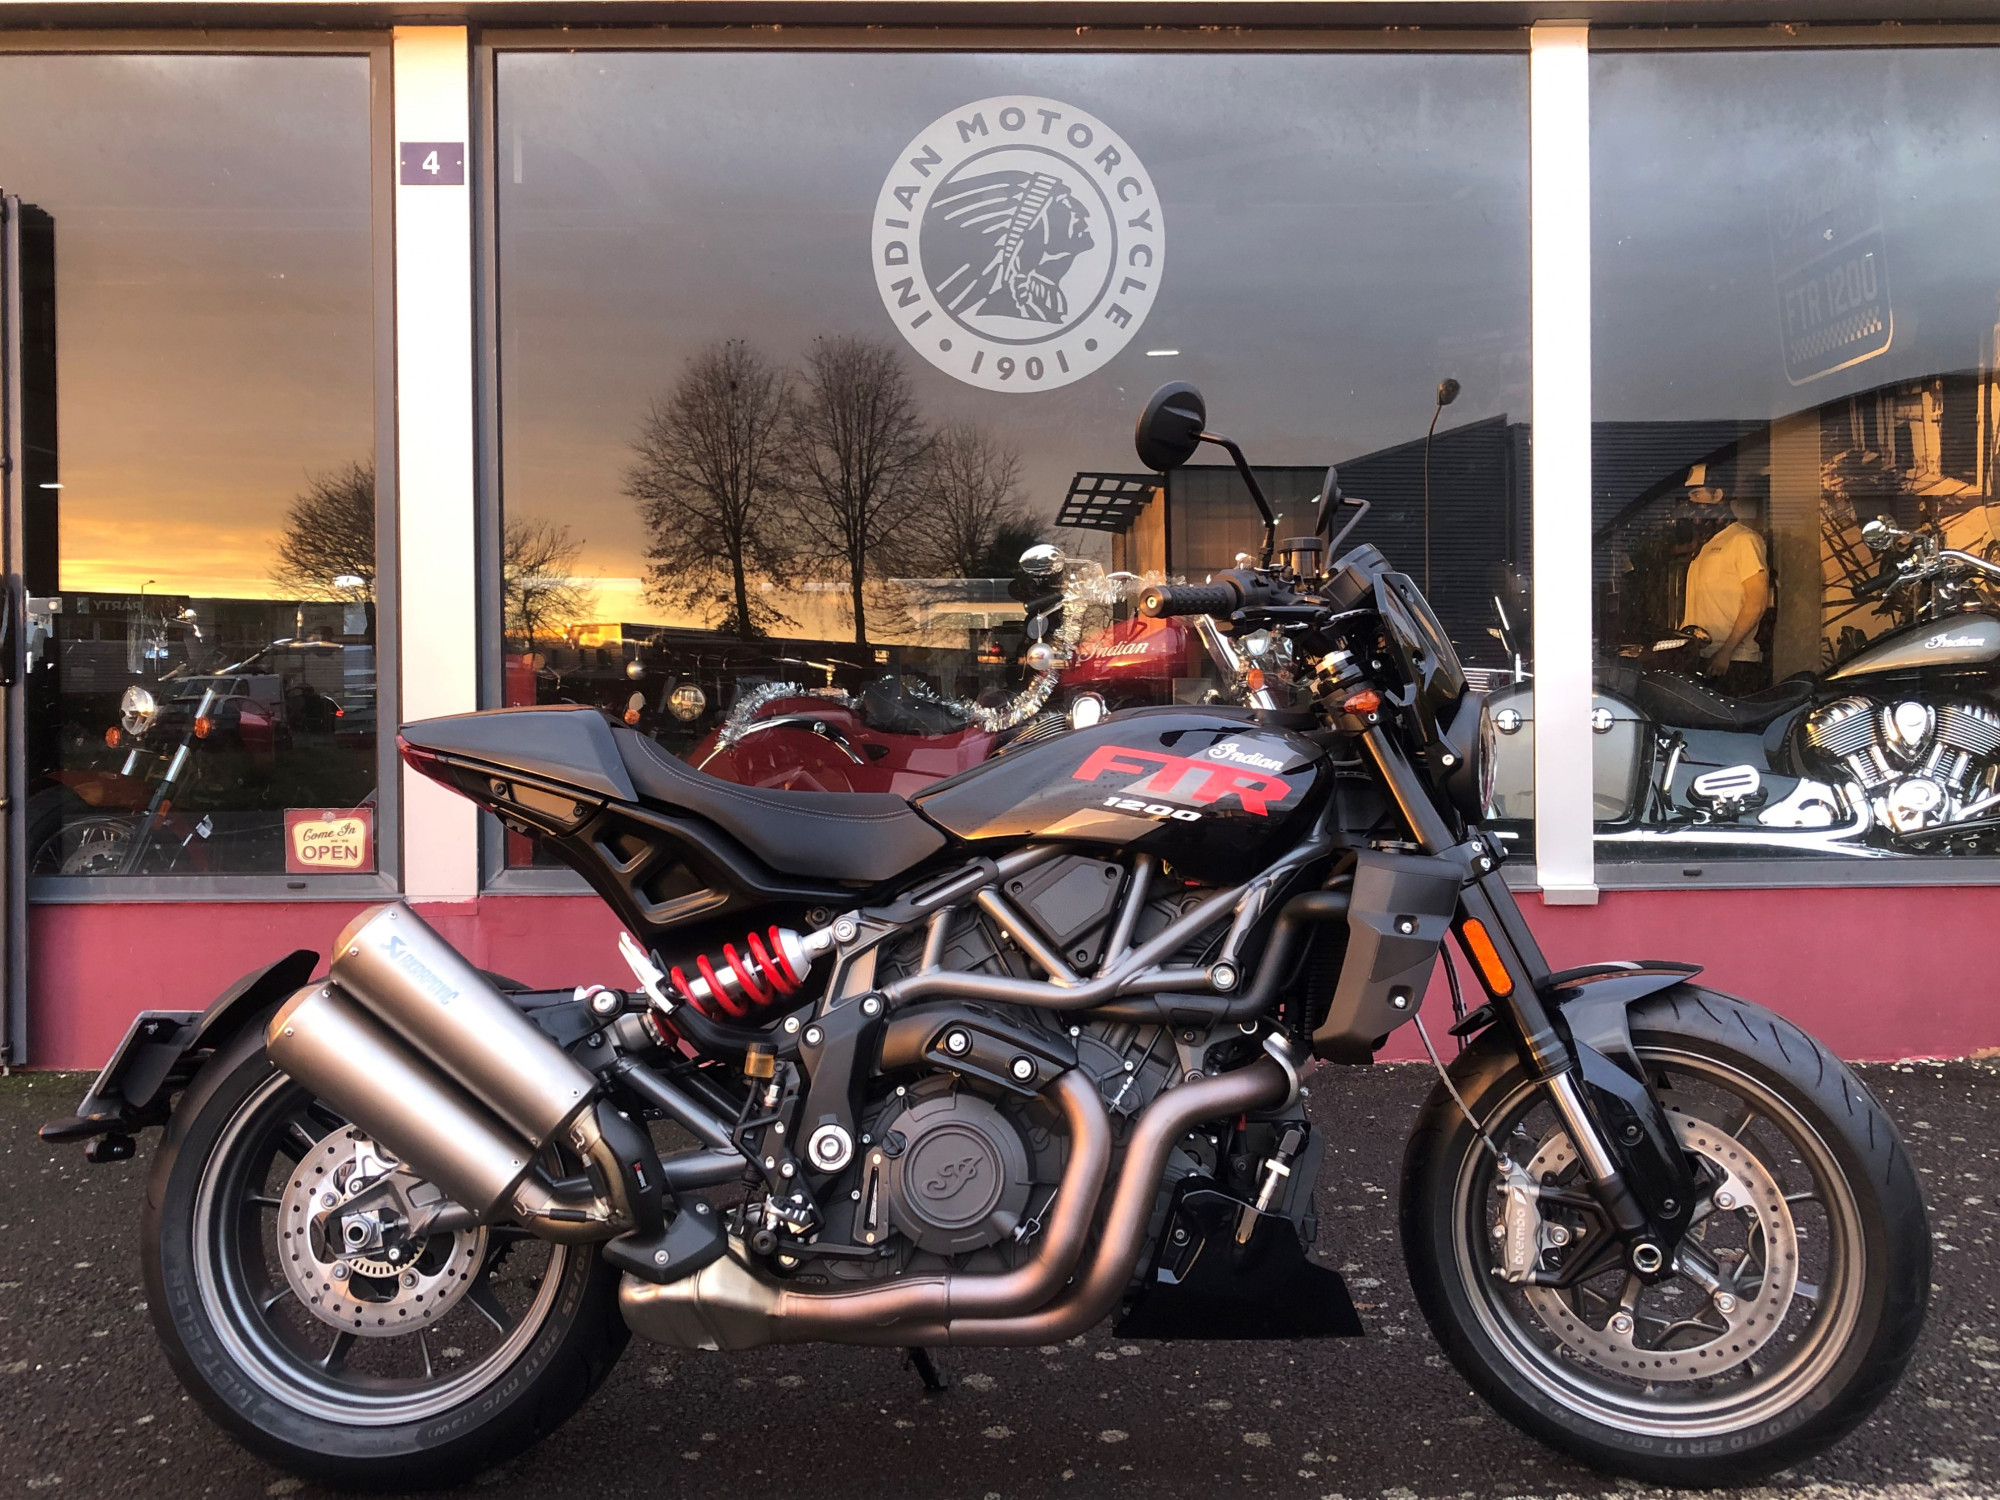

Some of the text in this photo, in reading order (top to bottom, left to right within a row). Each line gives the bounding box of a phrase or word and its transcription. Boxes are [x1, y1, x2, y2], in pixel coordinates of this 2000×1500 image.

[422, 151, 440, 175] 4
[885, 106, 1153, 329] INDIAN MOTORCYCLE
[1784, 253, 1878, 337] FTR 1200
[971, 349, 1070, 381] 1901
[1078, 641, 1149, 662] Indian
[1924, 633, 1986, 649] Indian
[1208, 742, 1284, 772] Indian
[1072, 745, 1292, 816] FTR
[1103, 796, 1202, 822] 1200
[303, 823, 356, 841] Come In
[302, 845, 358, 860] OPEN
[1513, 1207, 1526, 1265] brembo
[169, 1267, 254, 1409] METZELER
